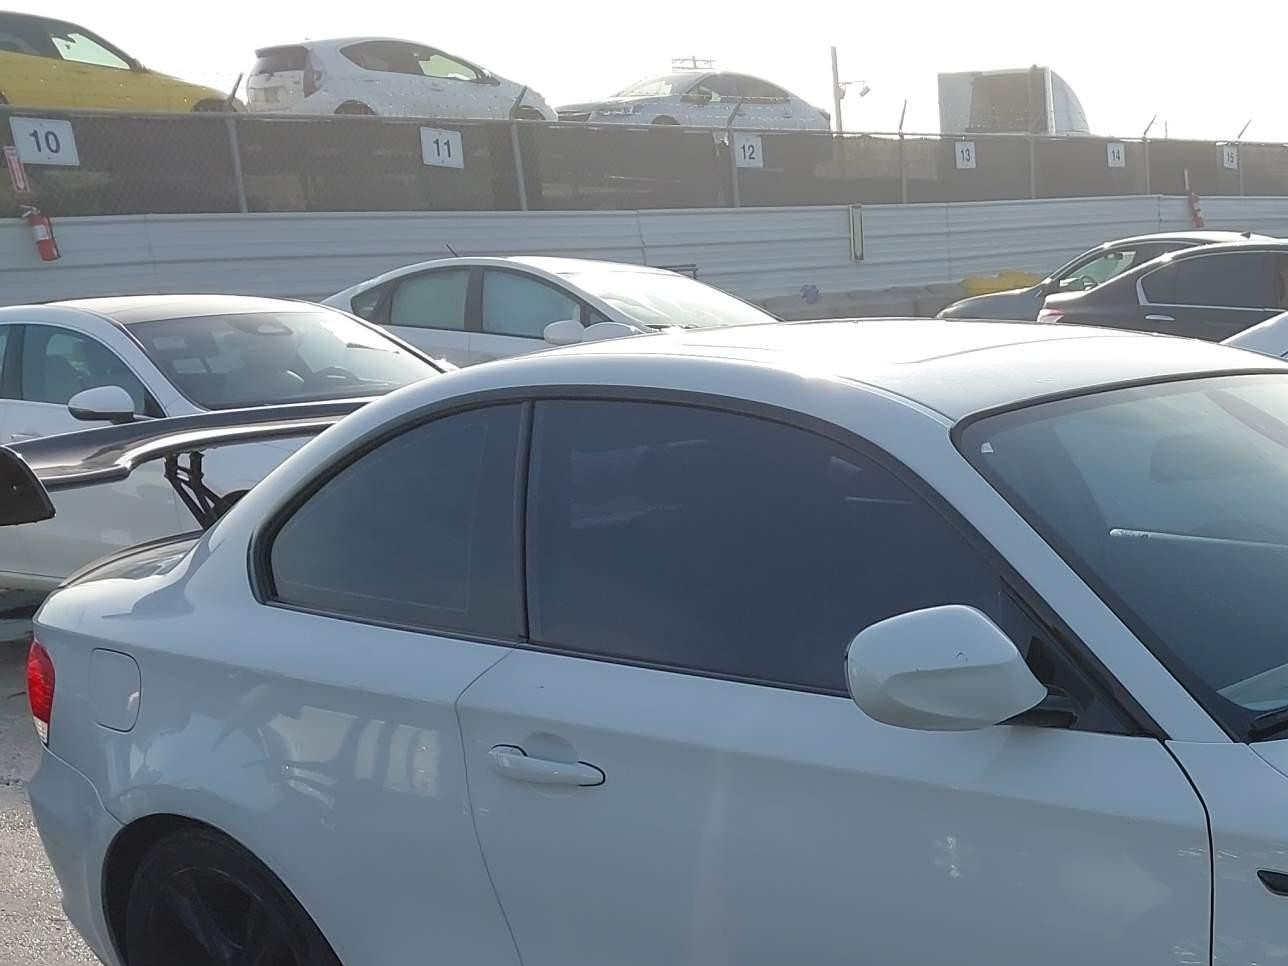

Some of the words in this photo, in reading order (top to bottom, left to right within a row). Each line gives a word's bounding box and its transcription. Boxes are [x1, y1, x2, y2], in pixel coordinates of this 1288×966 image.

[29, 129, 61, 154] 10
[433, 138, 452, 158] 11
[740, 143, 756, 160] 12
[960, 148, 971, 162] 13
